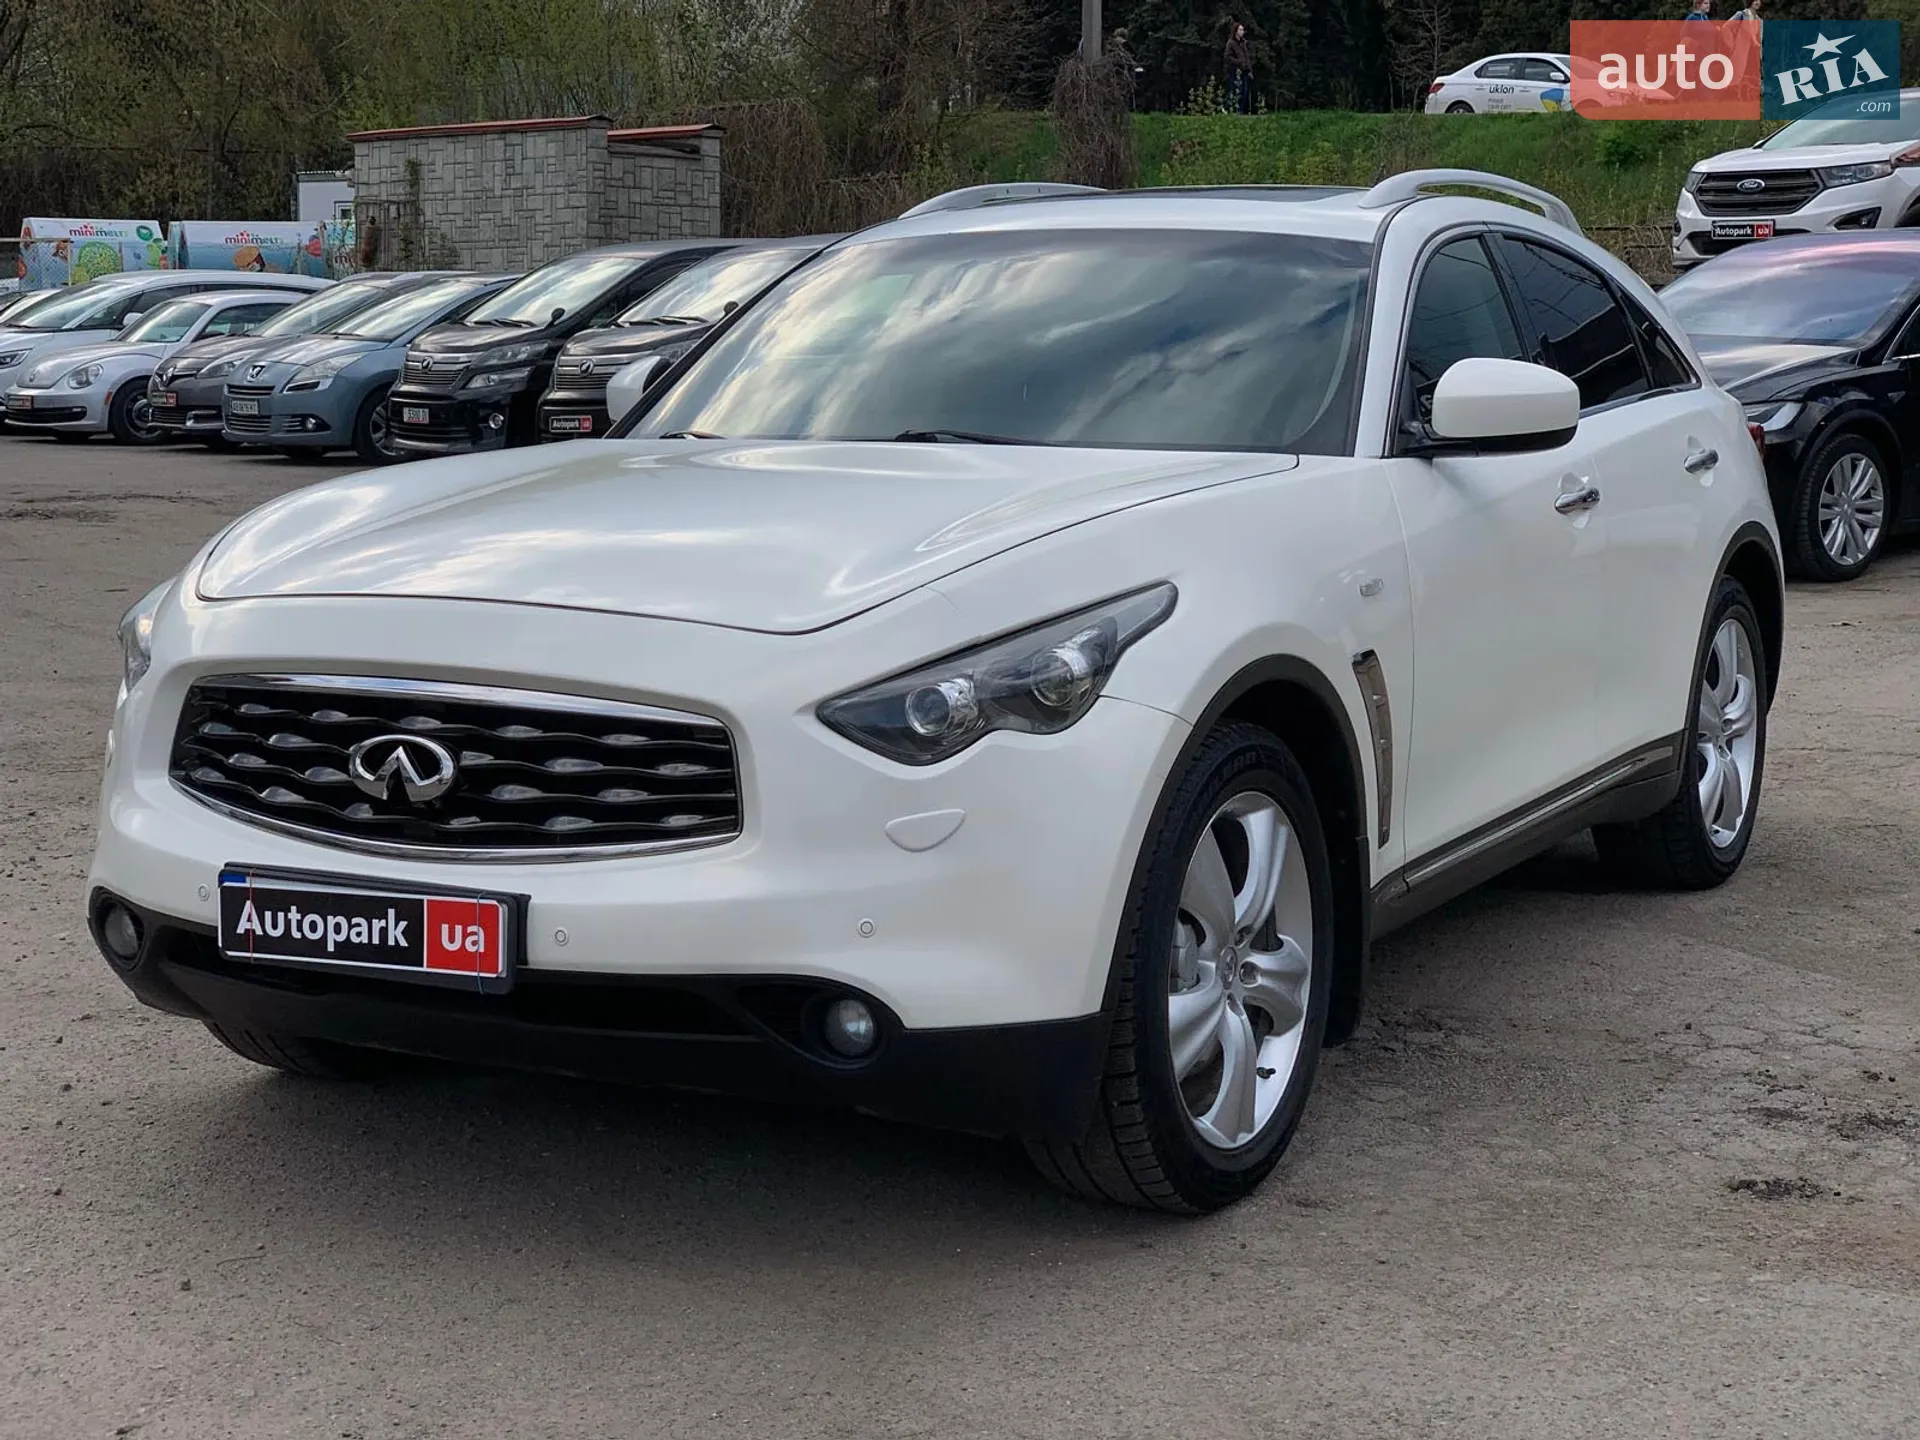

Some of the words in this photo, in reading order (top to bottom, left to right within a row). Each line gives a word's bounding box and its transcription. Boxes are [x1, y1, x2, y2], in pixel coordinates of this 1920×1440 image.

[1715, 226, 1752, 236] Autopark
[235, 899, 409, 952] Autopark
[440, 922, 485, 953] ua
